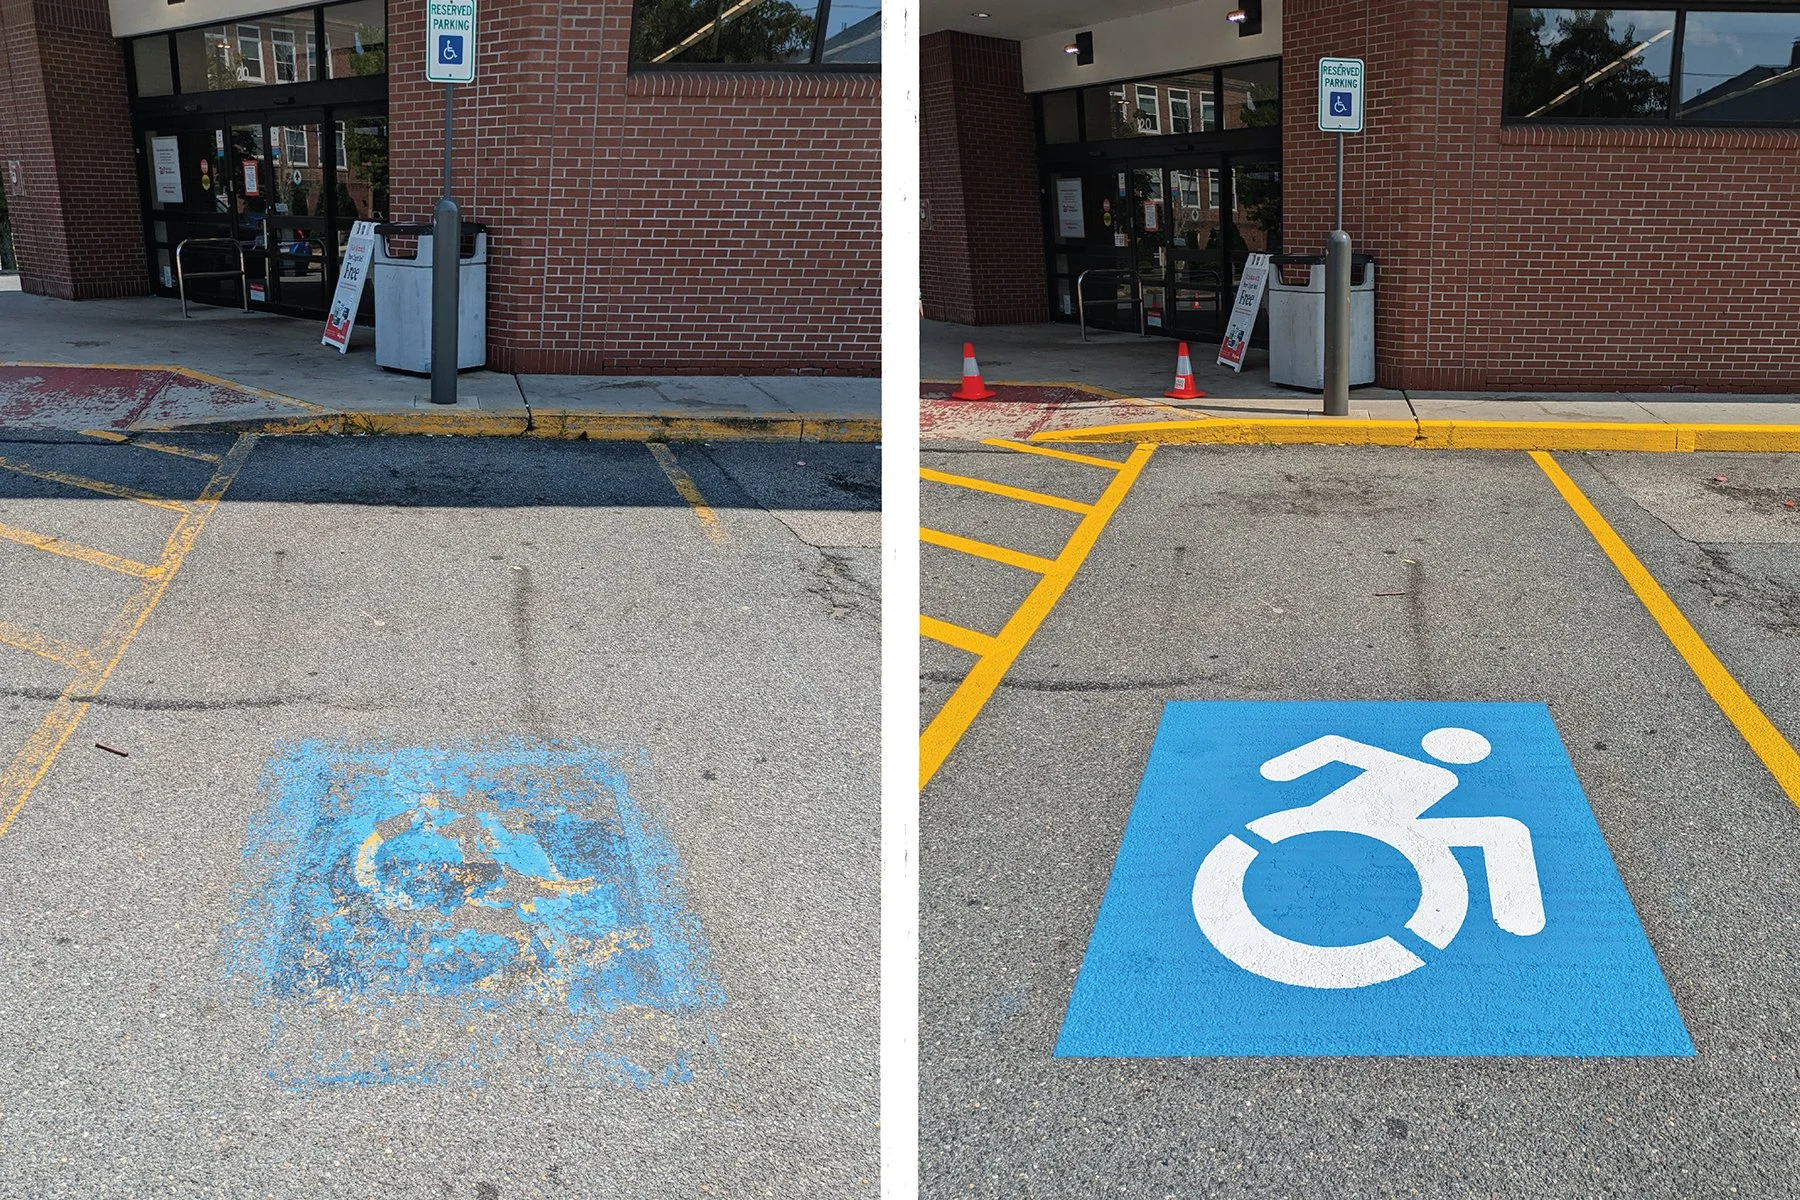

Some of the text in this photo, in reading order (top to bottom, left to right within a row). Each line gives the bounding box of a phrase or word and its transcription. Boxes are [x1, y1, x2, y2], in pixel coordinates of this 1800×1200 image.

[431, 4, 472, 16] RESERVED
[433, 19, 469, 31] PARKING
[236, 66, 249, 81] 20
[1323, 66, 1359, 76] RESERVED
[1325, 78, 1357, 88] PARKING
[343, 262, 360, 281] Free
[1239, 290, 1255, 306] Free
